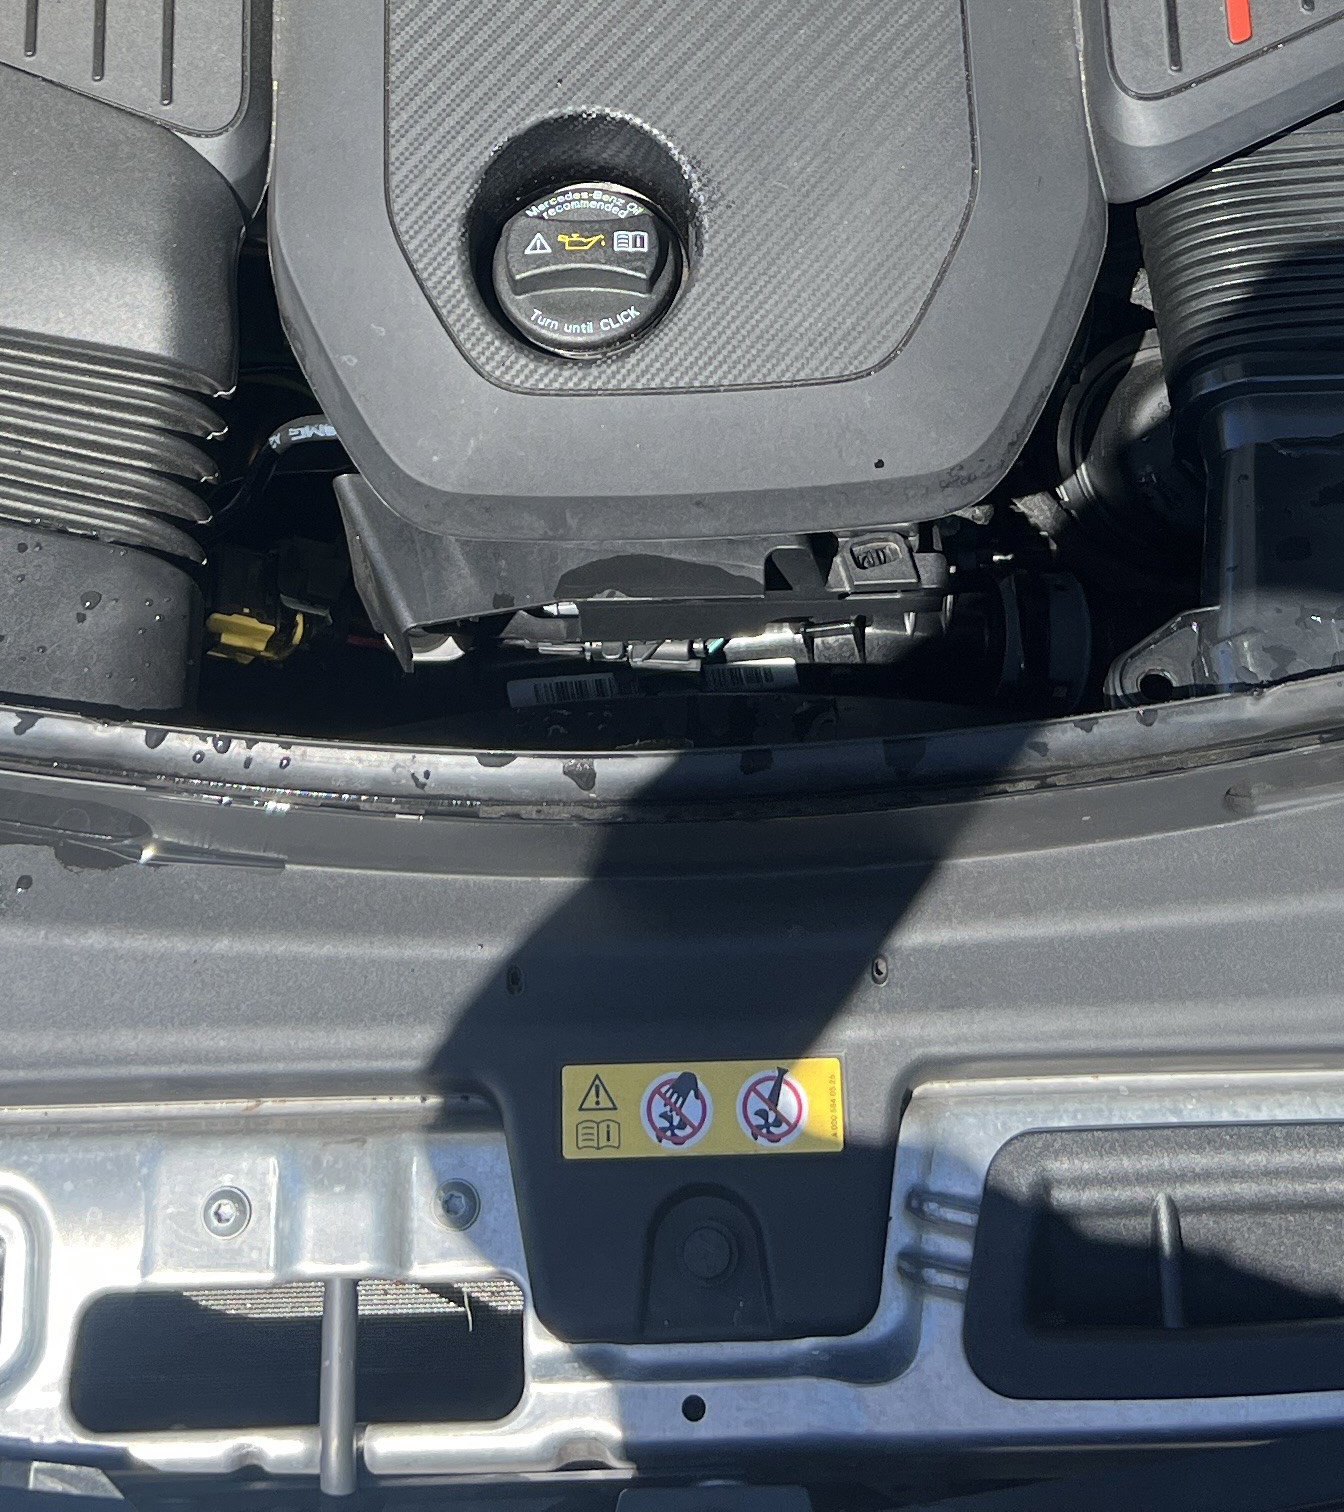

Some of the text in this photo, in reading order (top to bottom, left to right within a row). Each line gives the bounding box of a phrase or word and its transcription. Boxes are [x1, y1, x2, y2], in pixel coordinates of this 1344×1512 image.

[525, 190, 646, 218] Mercedes-Benz Oil
[542, 199, 630, 220] recommended
[530, 305, 641, 334] Turn until CLICK
